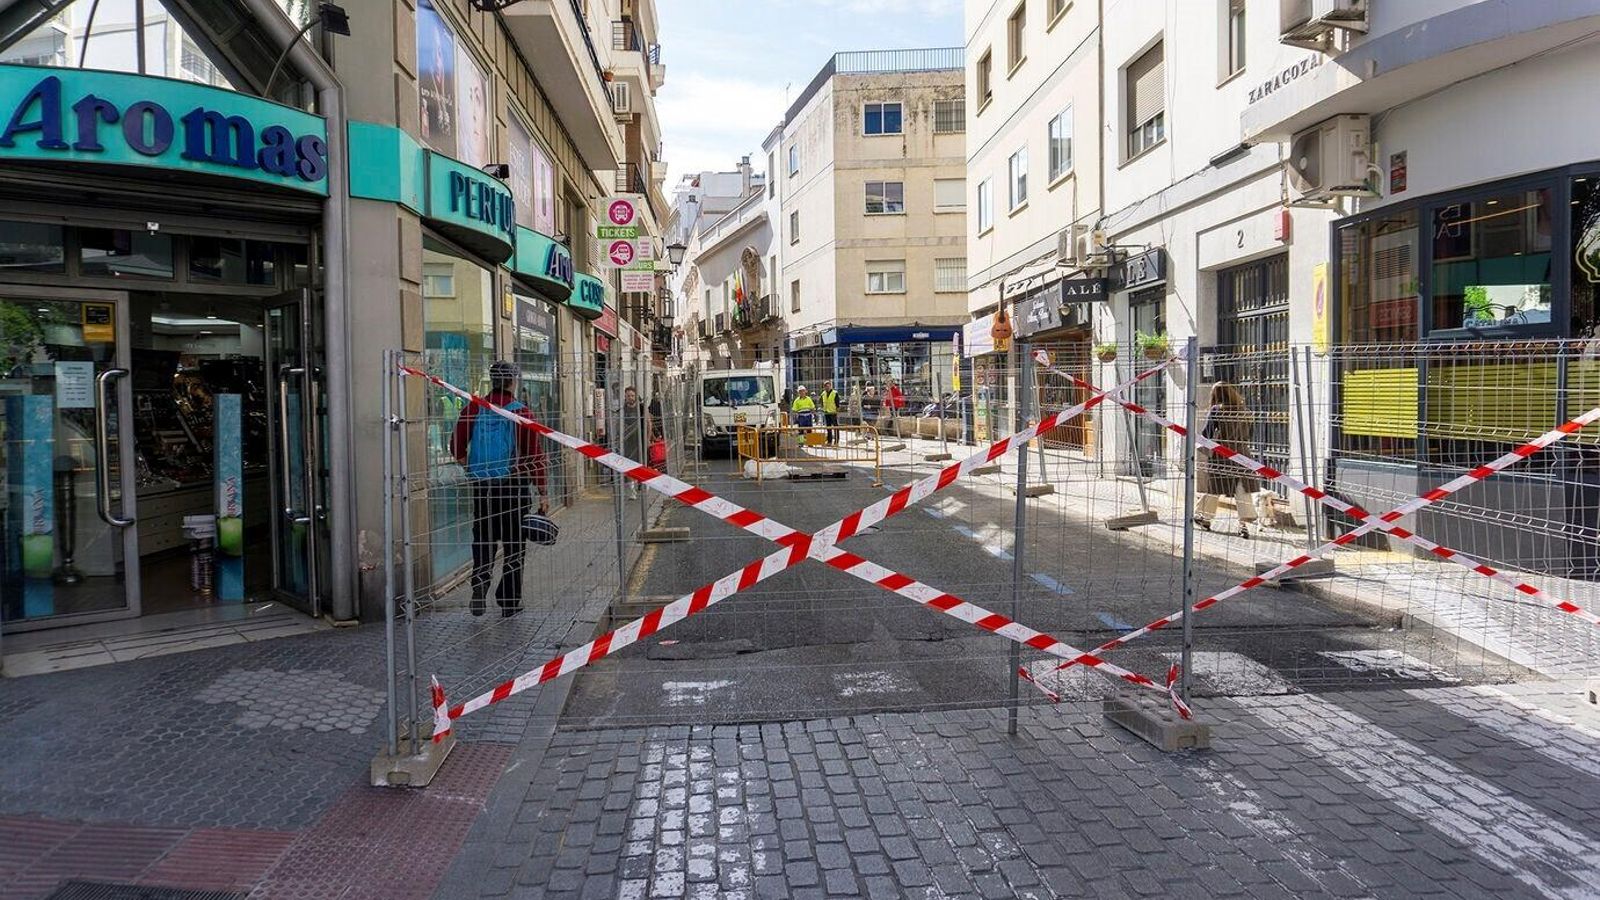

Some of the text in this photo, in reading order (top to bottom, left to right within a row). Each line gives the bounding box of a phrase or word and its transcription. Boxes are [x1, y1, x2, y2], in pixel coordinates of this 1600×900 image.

[1248, 53, 1318, 105] ZARAGOZA
[0, 76, 328, 182] Aromas
[601, 228, 635, 238] TICKETS
[1237, 229, 1244, 248] 2
[1066, 282, 1101, 296] ALÉ
